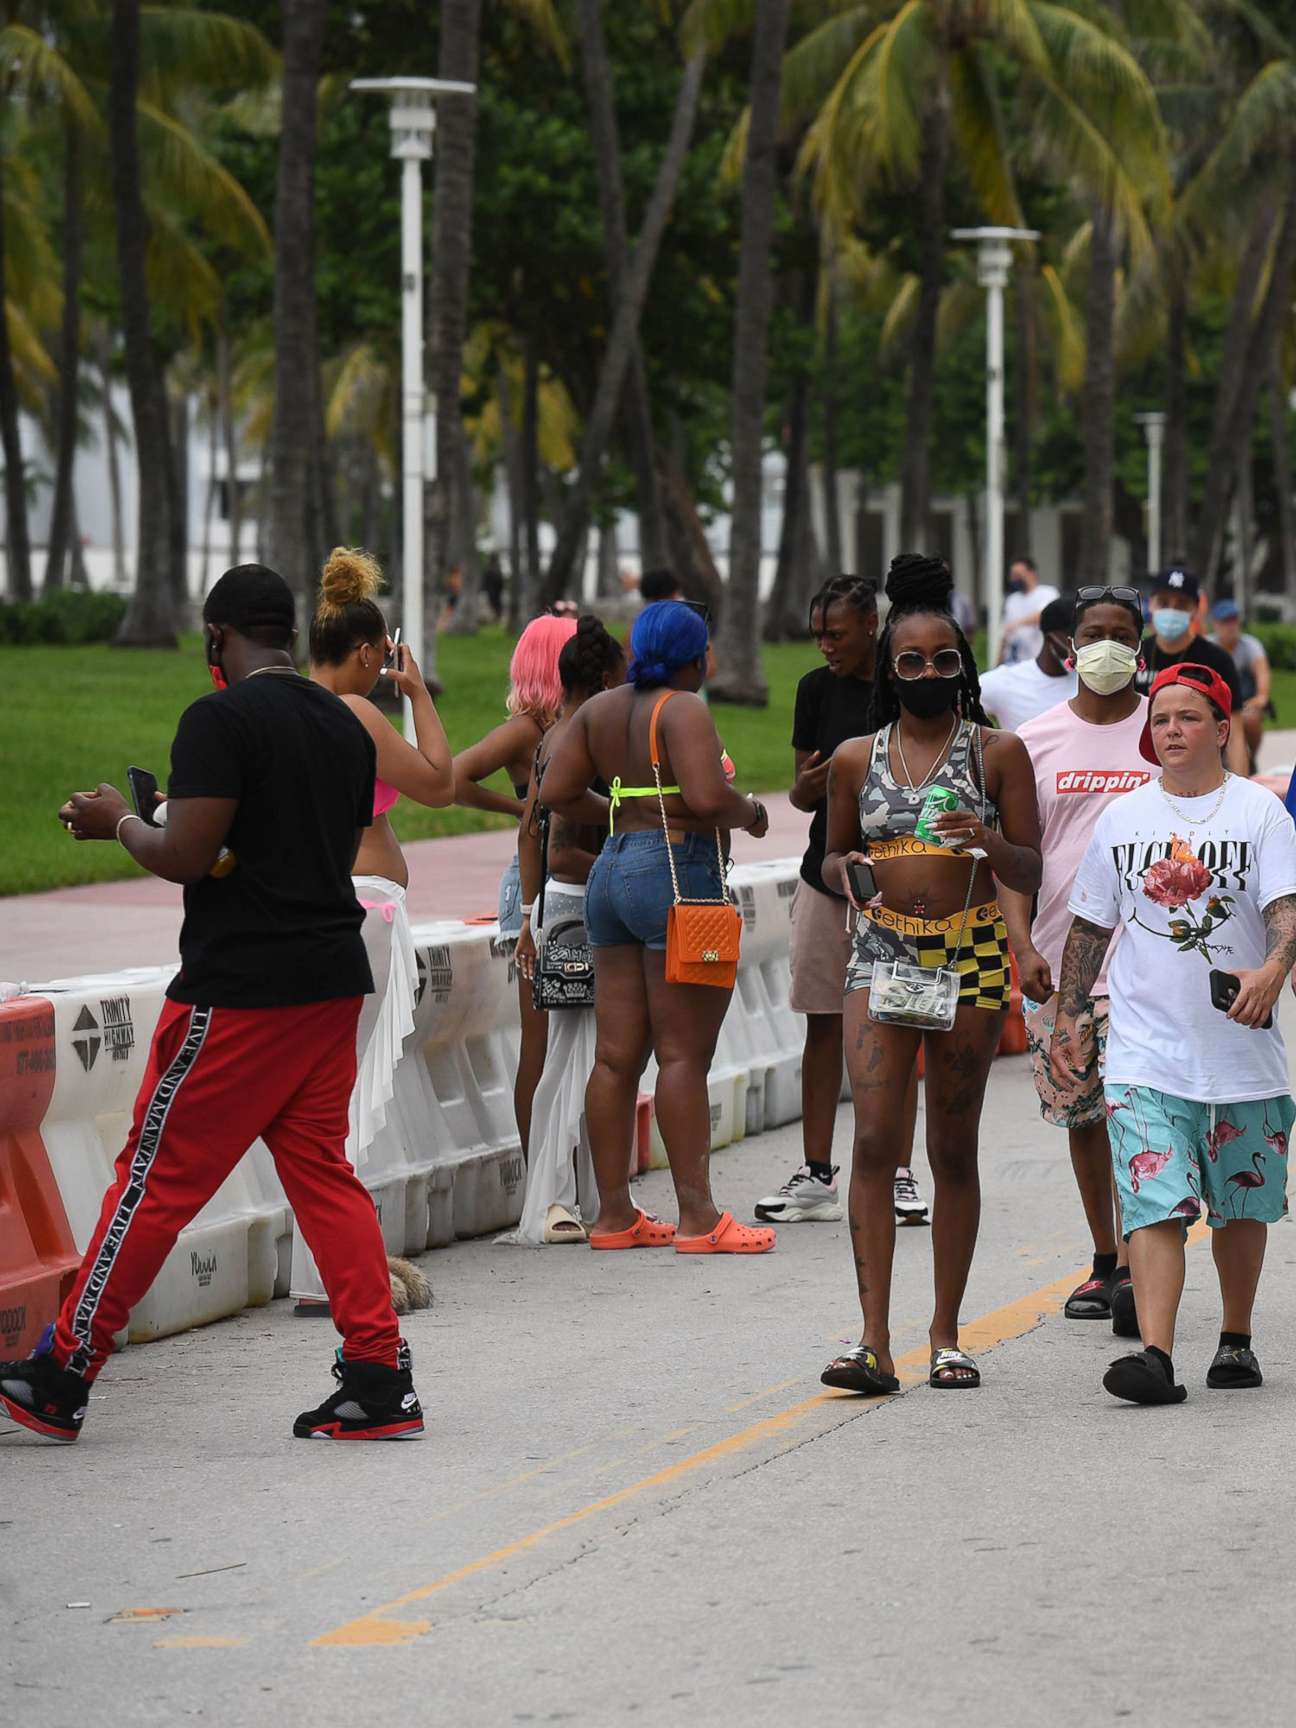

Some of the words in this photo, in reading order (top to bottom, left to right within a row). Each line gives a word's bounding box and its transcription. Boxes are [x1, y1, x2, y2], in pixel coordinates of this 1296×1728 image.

[874, 839, 927, 858] ethika
[1198, 840, 1251, 891] OFF
[882, 911, 954, 935] ethika
[100, 996, 132, 1024] TRINITY
[159, 1059, 188, 1098] AND
[131, 1101, 167, 1191] MAINTAIN
[104, 1206, 132, 1250] LIVE
[89, 1249, 113, 1292] AND
